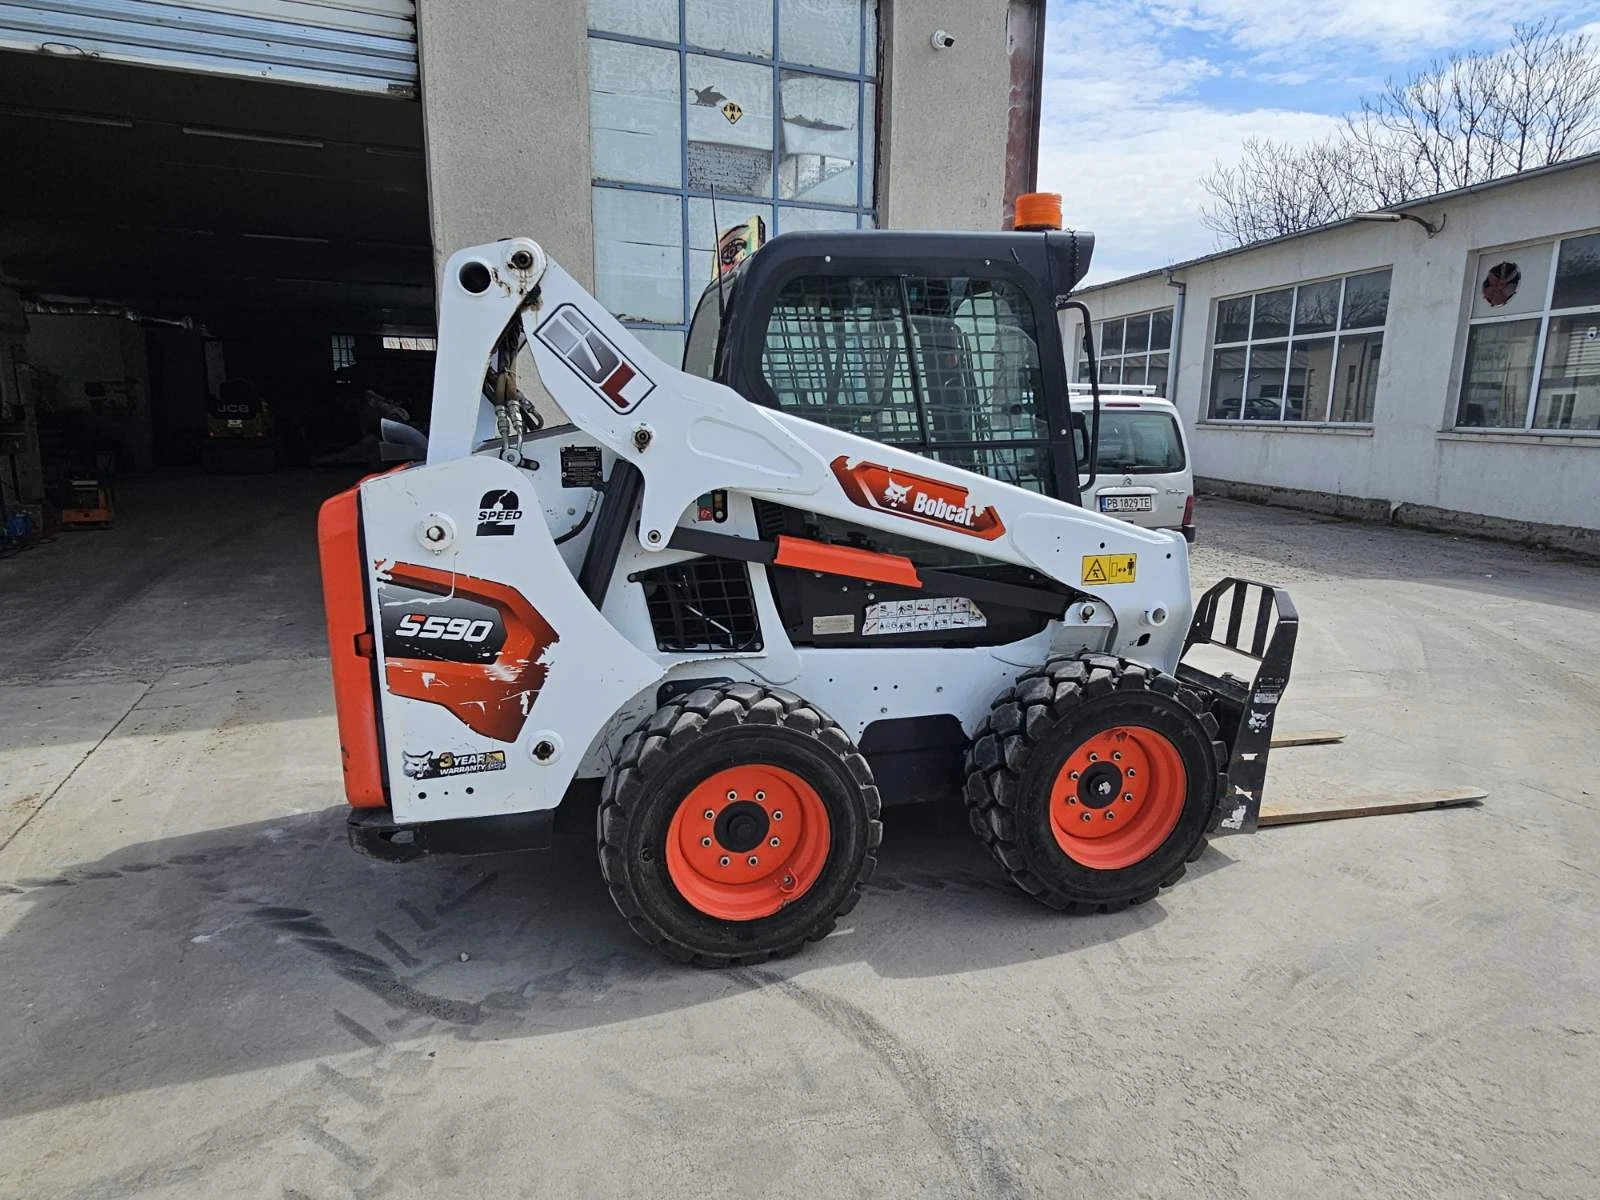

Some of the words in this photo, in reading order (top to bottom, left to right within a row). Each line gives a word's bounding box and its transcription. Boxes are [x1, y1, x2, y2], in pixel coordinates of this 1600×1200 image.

[217, 404, 249, 412] JCB
[1107, 498, 1118, 508] PB
[1120, 498, 1139, 508] 1829
[1140, 497, 1151, 508] TE
[912, 491, 974, 527] Bobcat
[477, 510, 523, 521] SPEED
[394, 613, 495, 643] S590
[439, 752, 454, 768] 3
[453, 754, 486, 766] YEAR
[440, 764, 486, 775] WARRANTY
